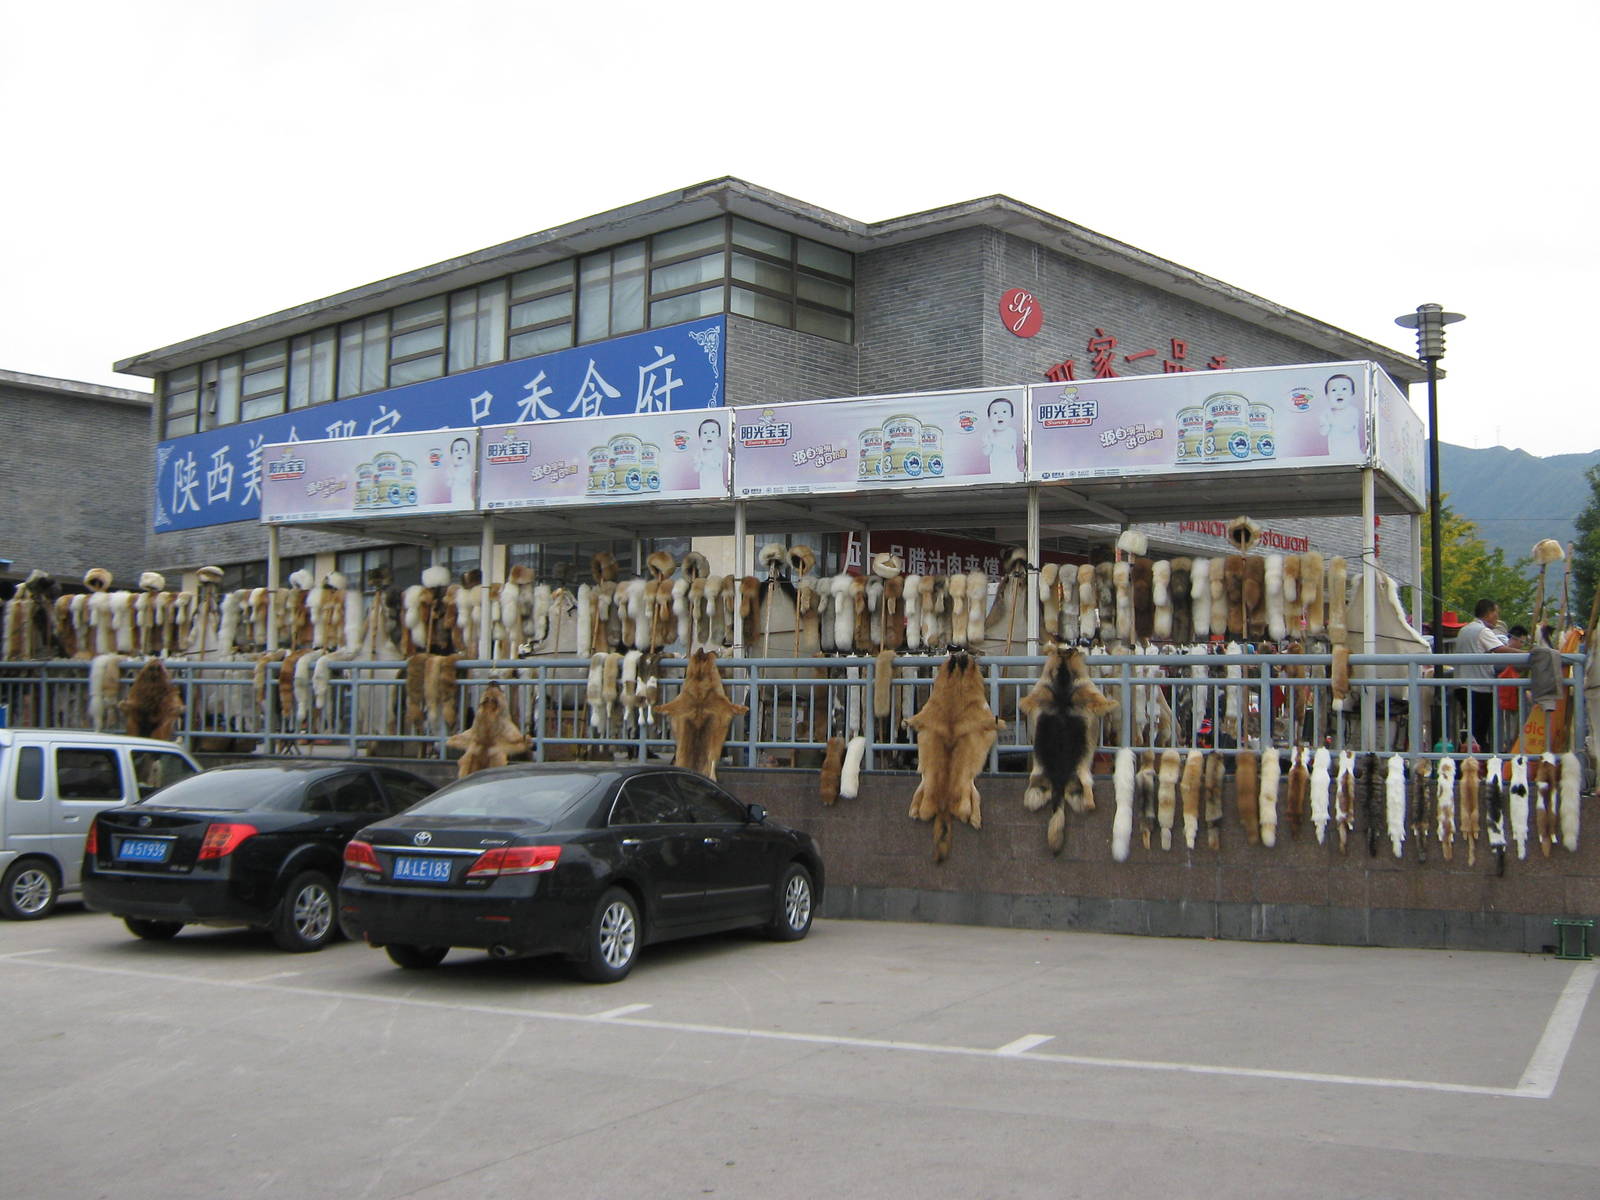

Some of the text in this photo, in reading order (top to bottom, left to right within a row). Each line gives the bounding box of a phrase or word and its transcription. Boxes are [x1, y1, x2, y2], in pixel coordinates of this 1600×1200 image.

[1039, 401, 1095, 420] 阳光宝宝
[740, 422, 790, 440] 阳光宝宝
[487, 440, 530, 457] 阳光宝宝
[1177, 441, 1187, 457] 3
[1204, 435, 1216, 454] 3
[881, 455, 893, 472] 3
[607, 471, 617, 487] 3
[1178, 520, 1233, 541] pinxian
[1523, 721, 1545, 737] dic
